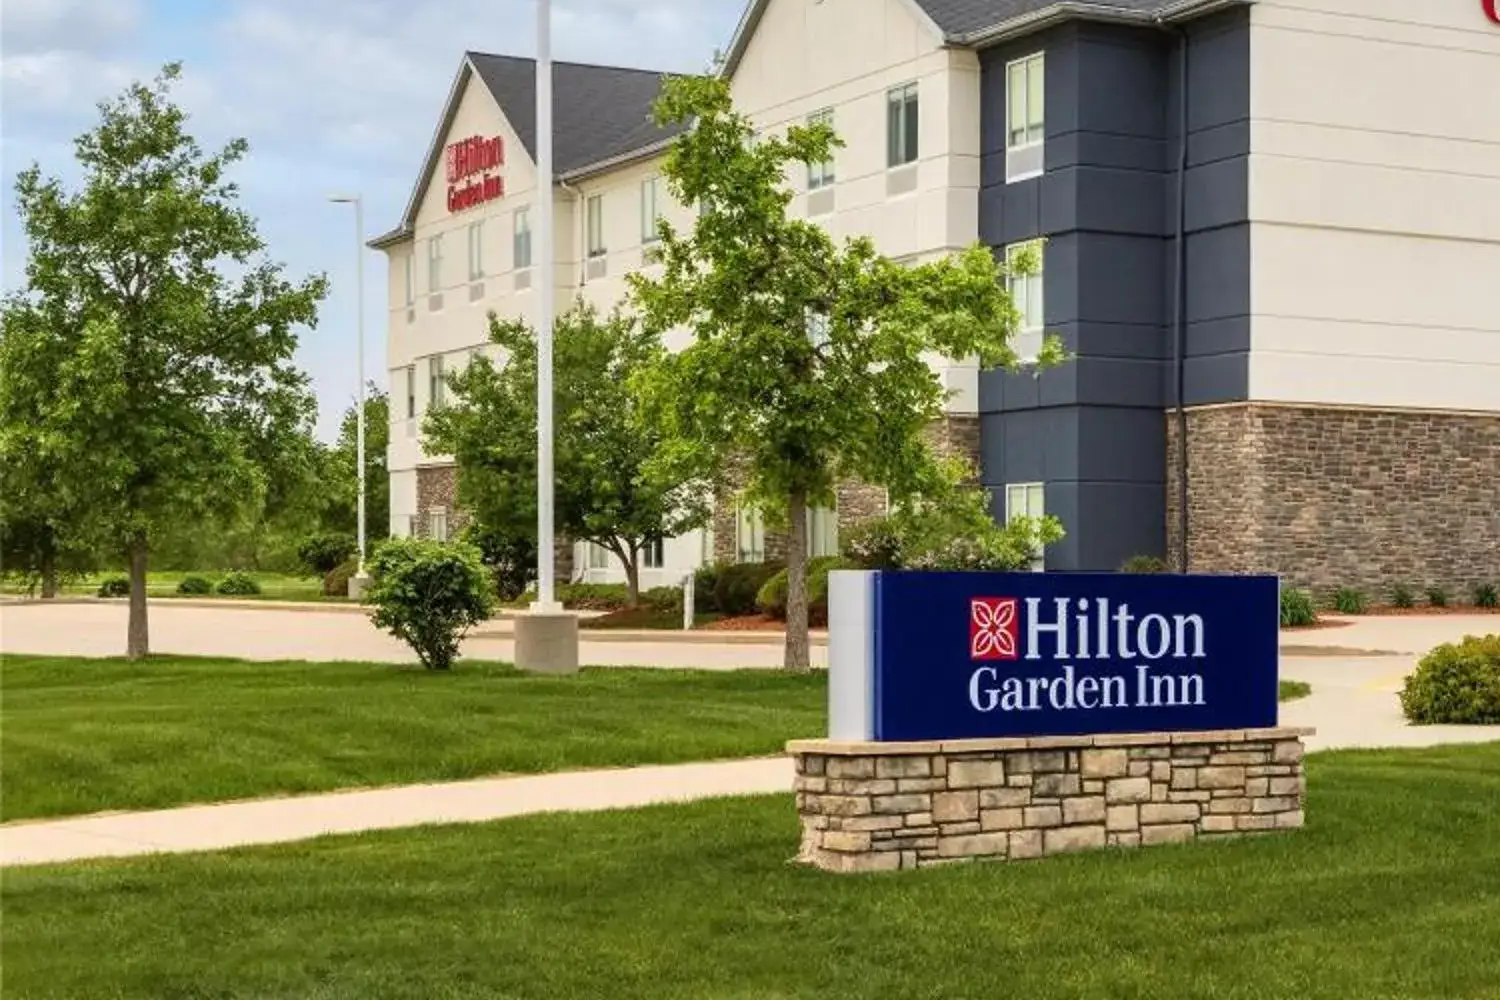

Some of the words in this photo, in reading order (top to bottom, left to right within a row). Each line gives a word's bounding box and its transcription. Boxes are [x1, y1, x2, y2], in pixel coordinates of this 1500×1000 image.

[1023, 597, 1208, 661] Hilton
[968, 664, 1129, 712] Garden
[1134, 664, 1208, 708] Inn
